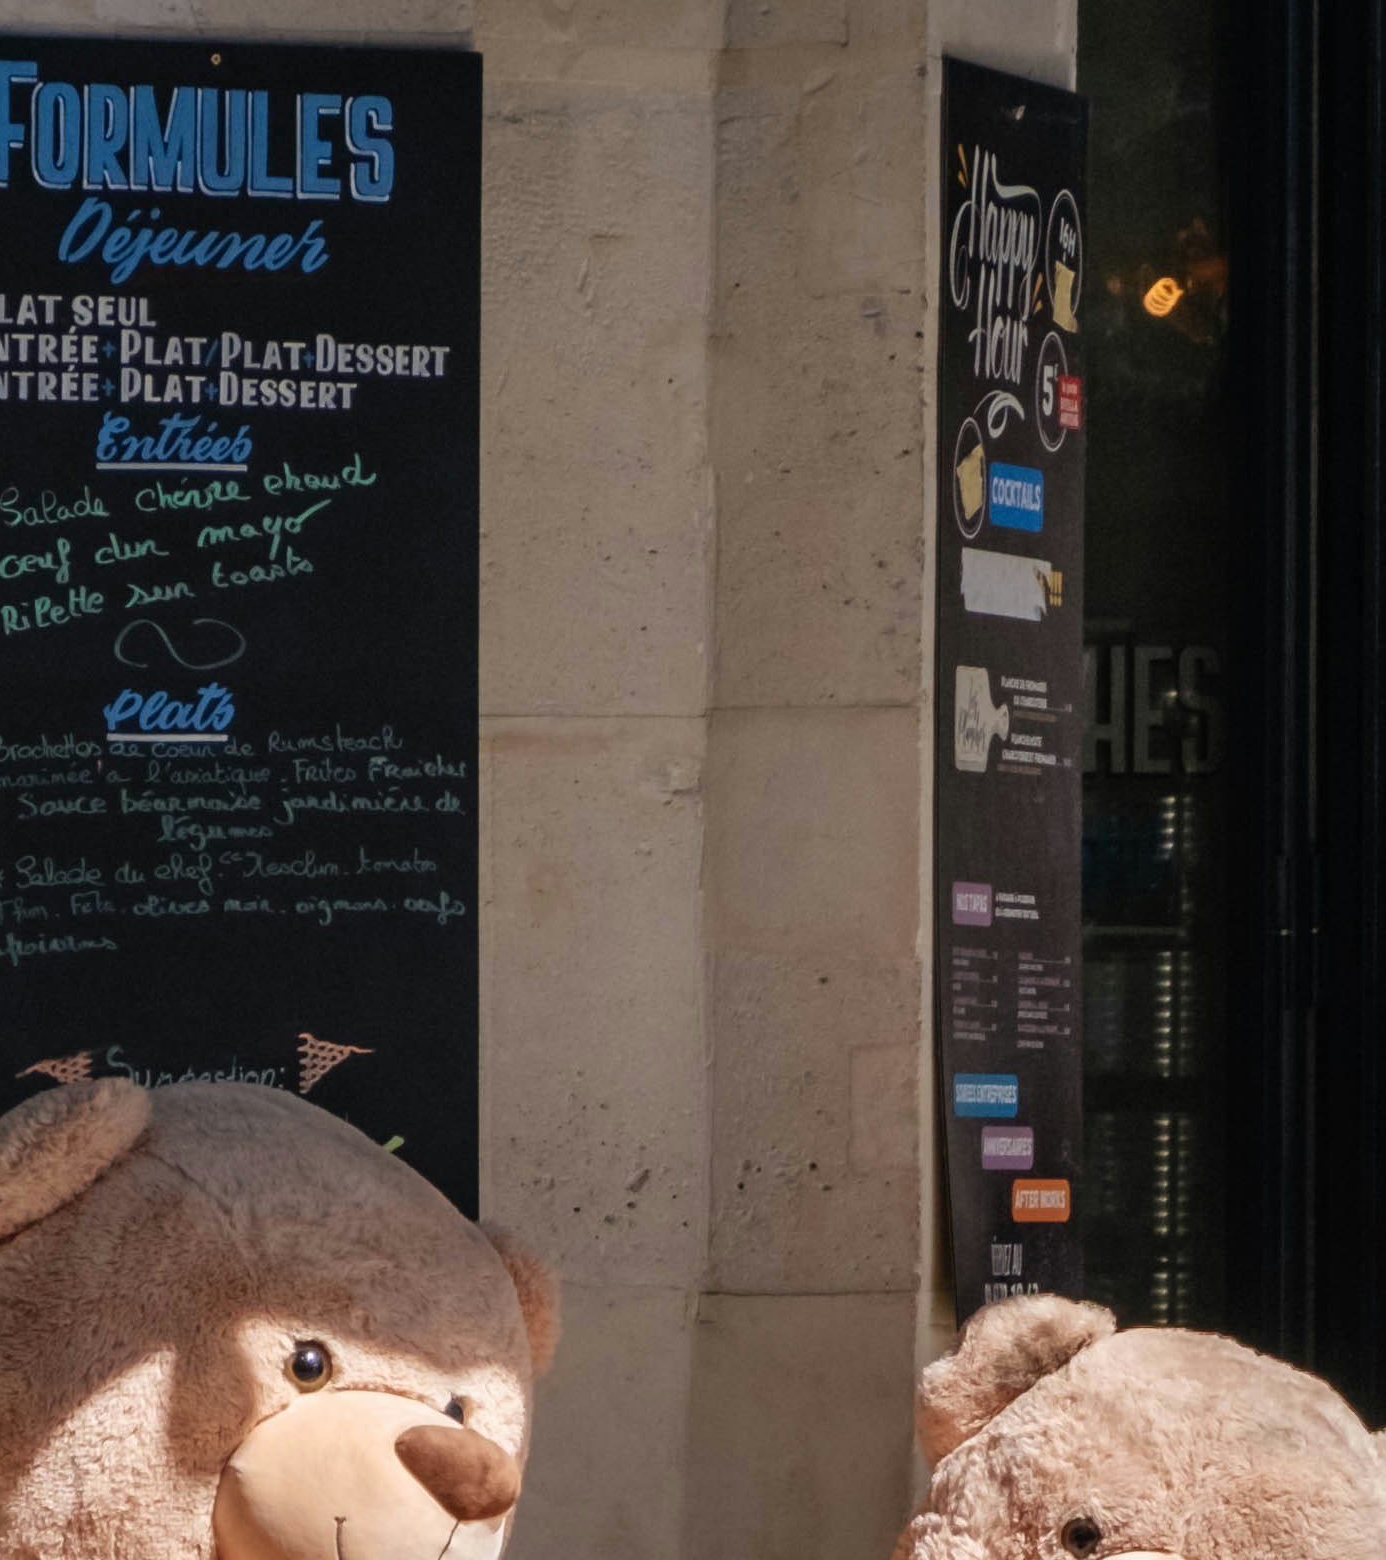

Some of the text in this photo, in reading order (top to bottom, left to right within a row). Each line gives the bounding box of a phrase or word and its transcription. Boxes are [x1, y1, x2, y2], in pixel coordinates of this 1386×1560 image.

[59, 196, 330, 284] Déjeuner
[949, 143, 1043, 322] Happy
[1058, 216, 1077, 259] 16H
[71, 294, 157, 328] SEUL
[967, 262, 1029, 385] Hour
[120, 328, 207, 367] PLAT
[220, 331, 306, 371] PLAT
[315, 333, 450, 378] DESSERT
[120, 368, 208, 404] PLAT
[219, 372, 358, 410] DESSERT
[97, 410, 253, 464] Entrées
[992, 476, 1042, 513] COCKTAILS
[197, 498, 332, 562] mayo
[125, 580, 197, 609] sur
[223, 737, 255, 757] de
[292, 757, 358, 784] Frites
[16, 792, 108, 817] Sauce
[435, 791, 466, 815] de
[14, 855, 108, 889] Salade
[114, 860, 147, 884] du
[1015, 1189, 1039, 1209] AFTER
